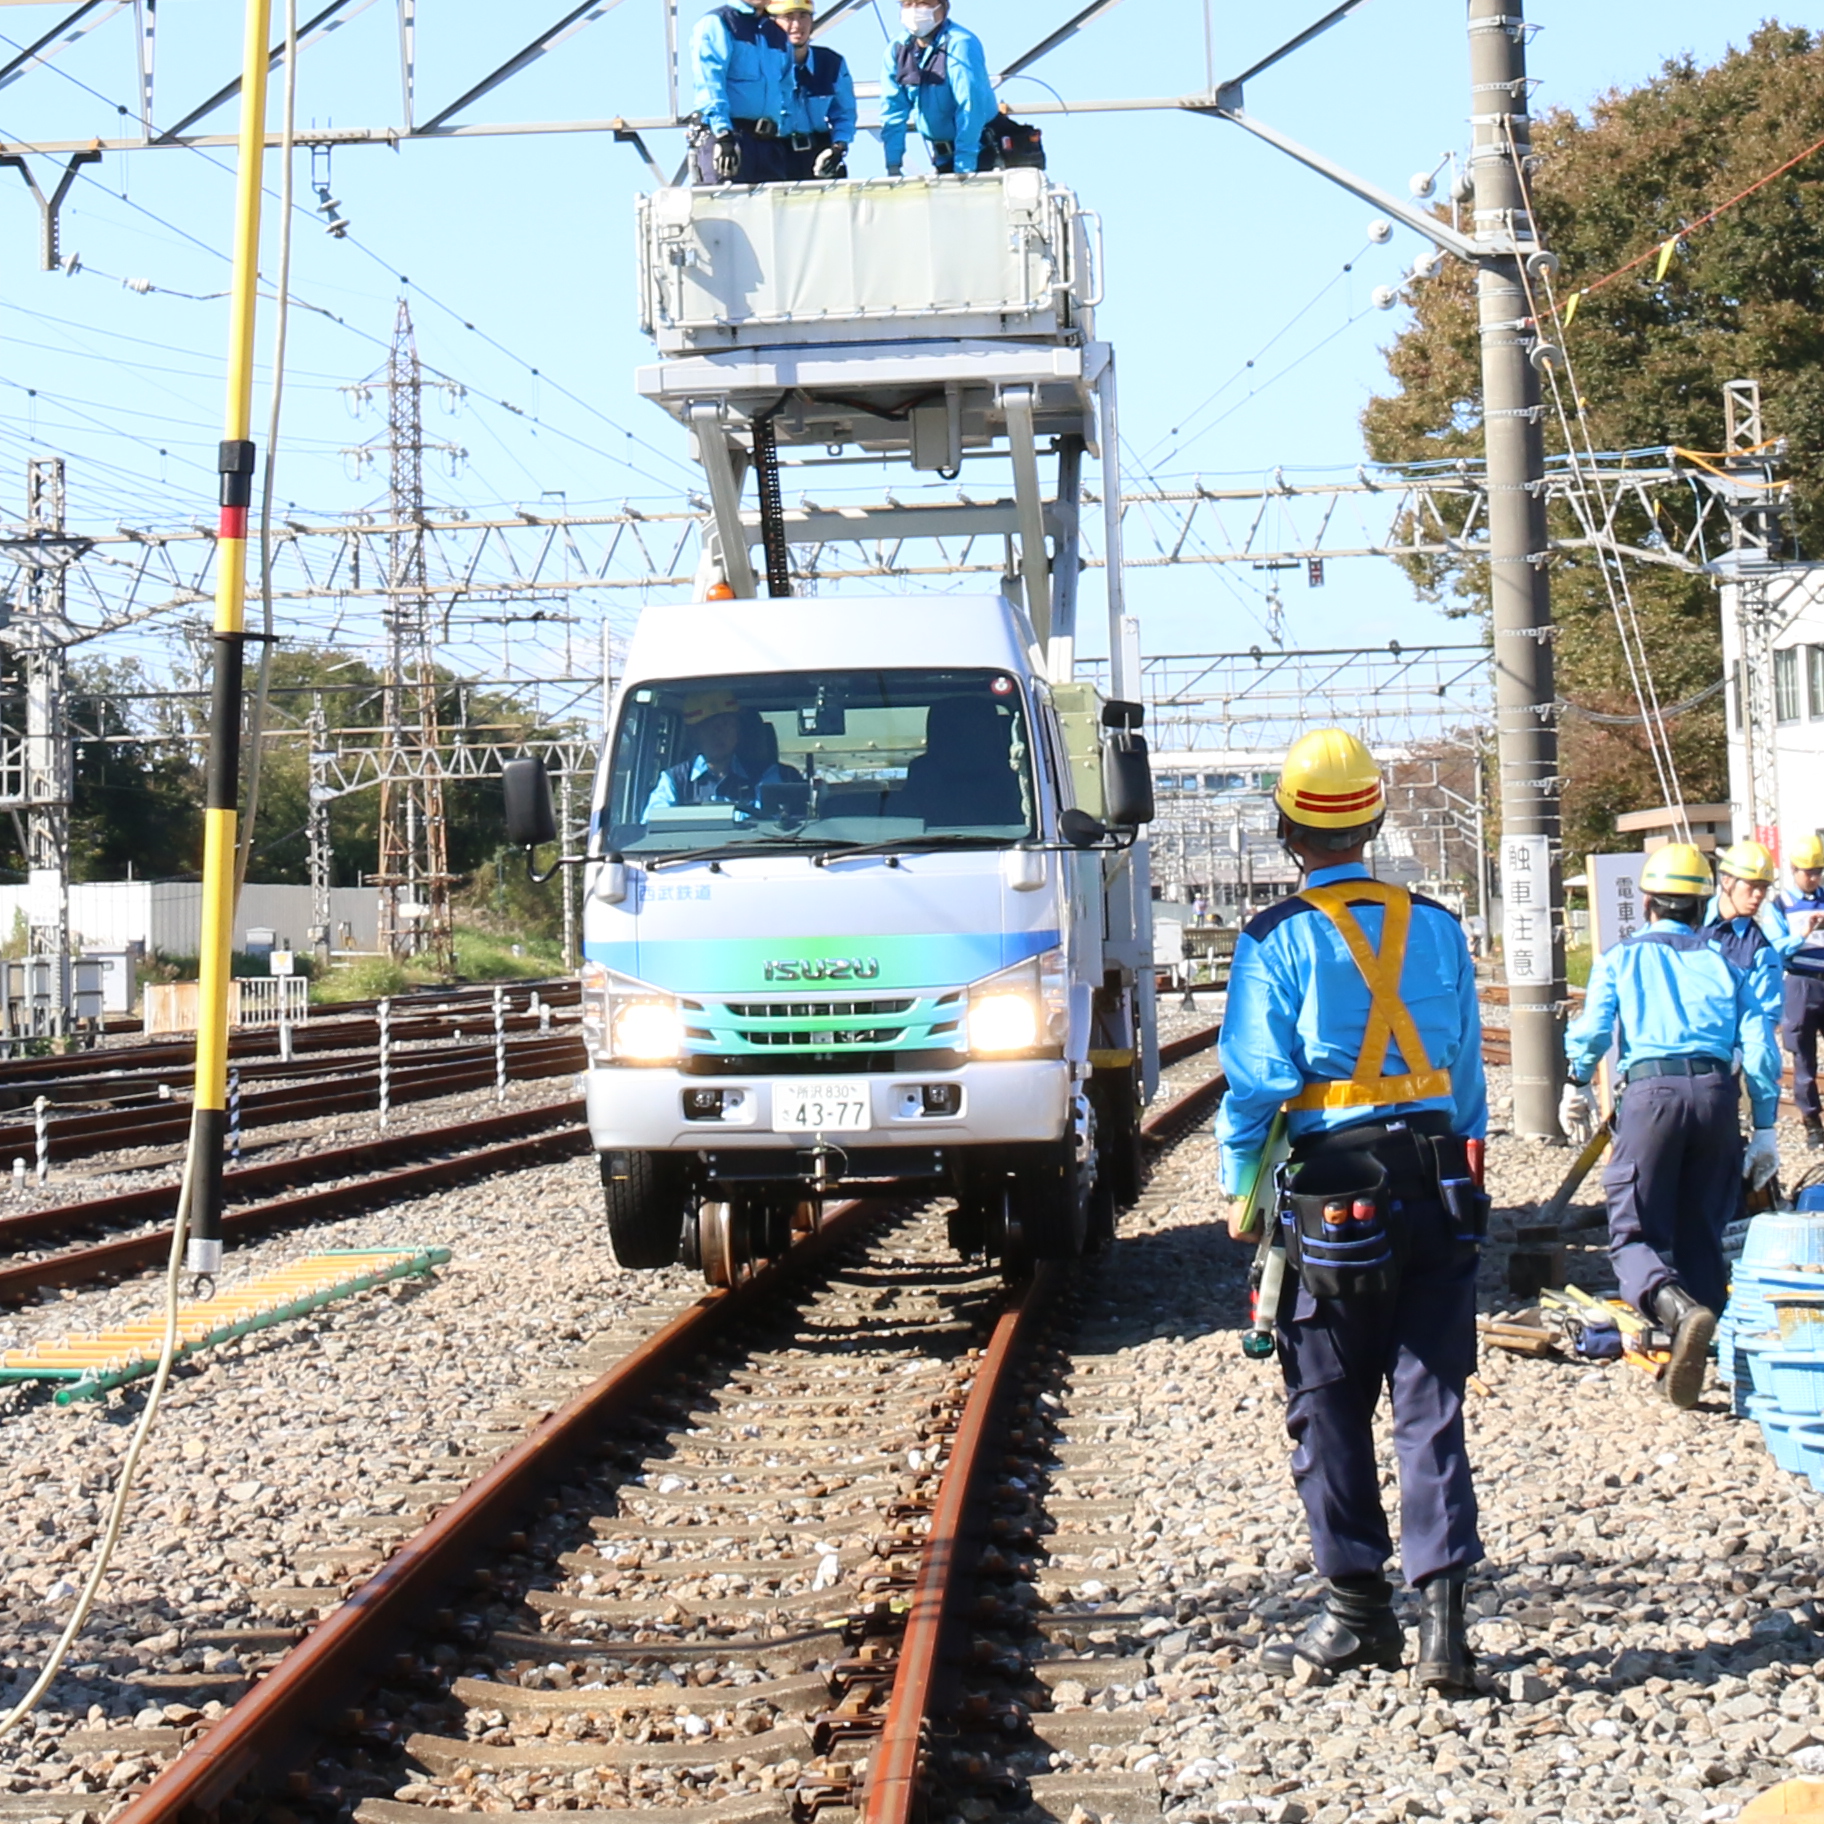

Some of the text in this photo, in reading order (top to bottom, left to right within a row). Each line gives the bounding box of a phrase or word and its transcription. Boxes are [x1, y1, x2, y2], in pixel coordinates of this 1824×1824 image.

[639, 884, 712, 901] 西武鉄道
[1508, 844, 1535, 976] 触車注意
[763, 956, 880, 981] ISUZU
[796, 1101, 865, 1126] 43-77
